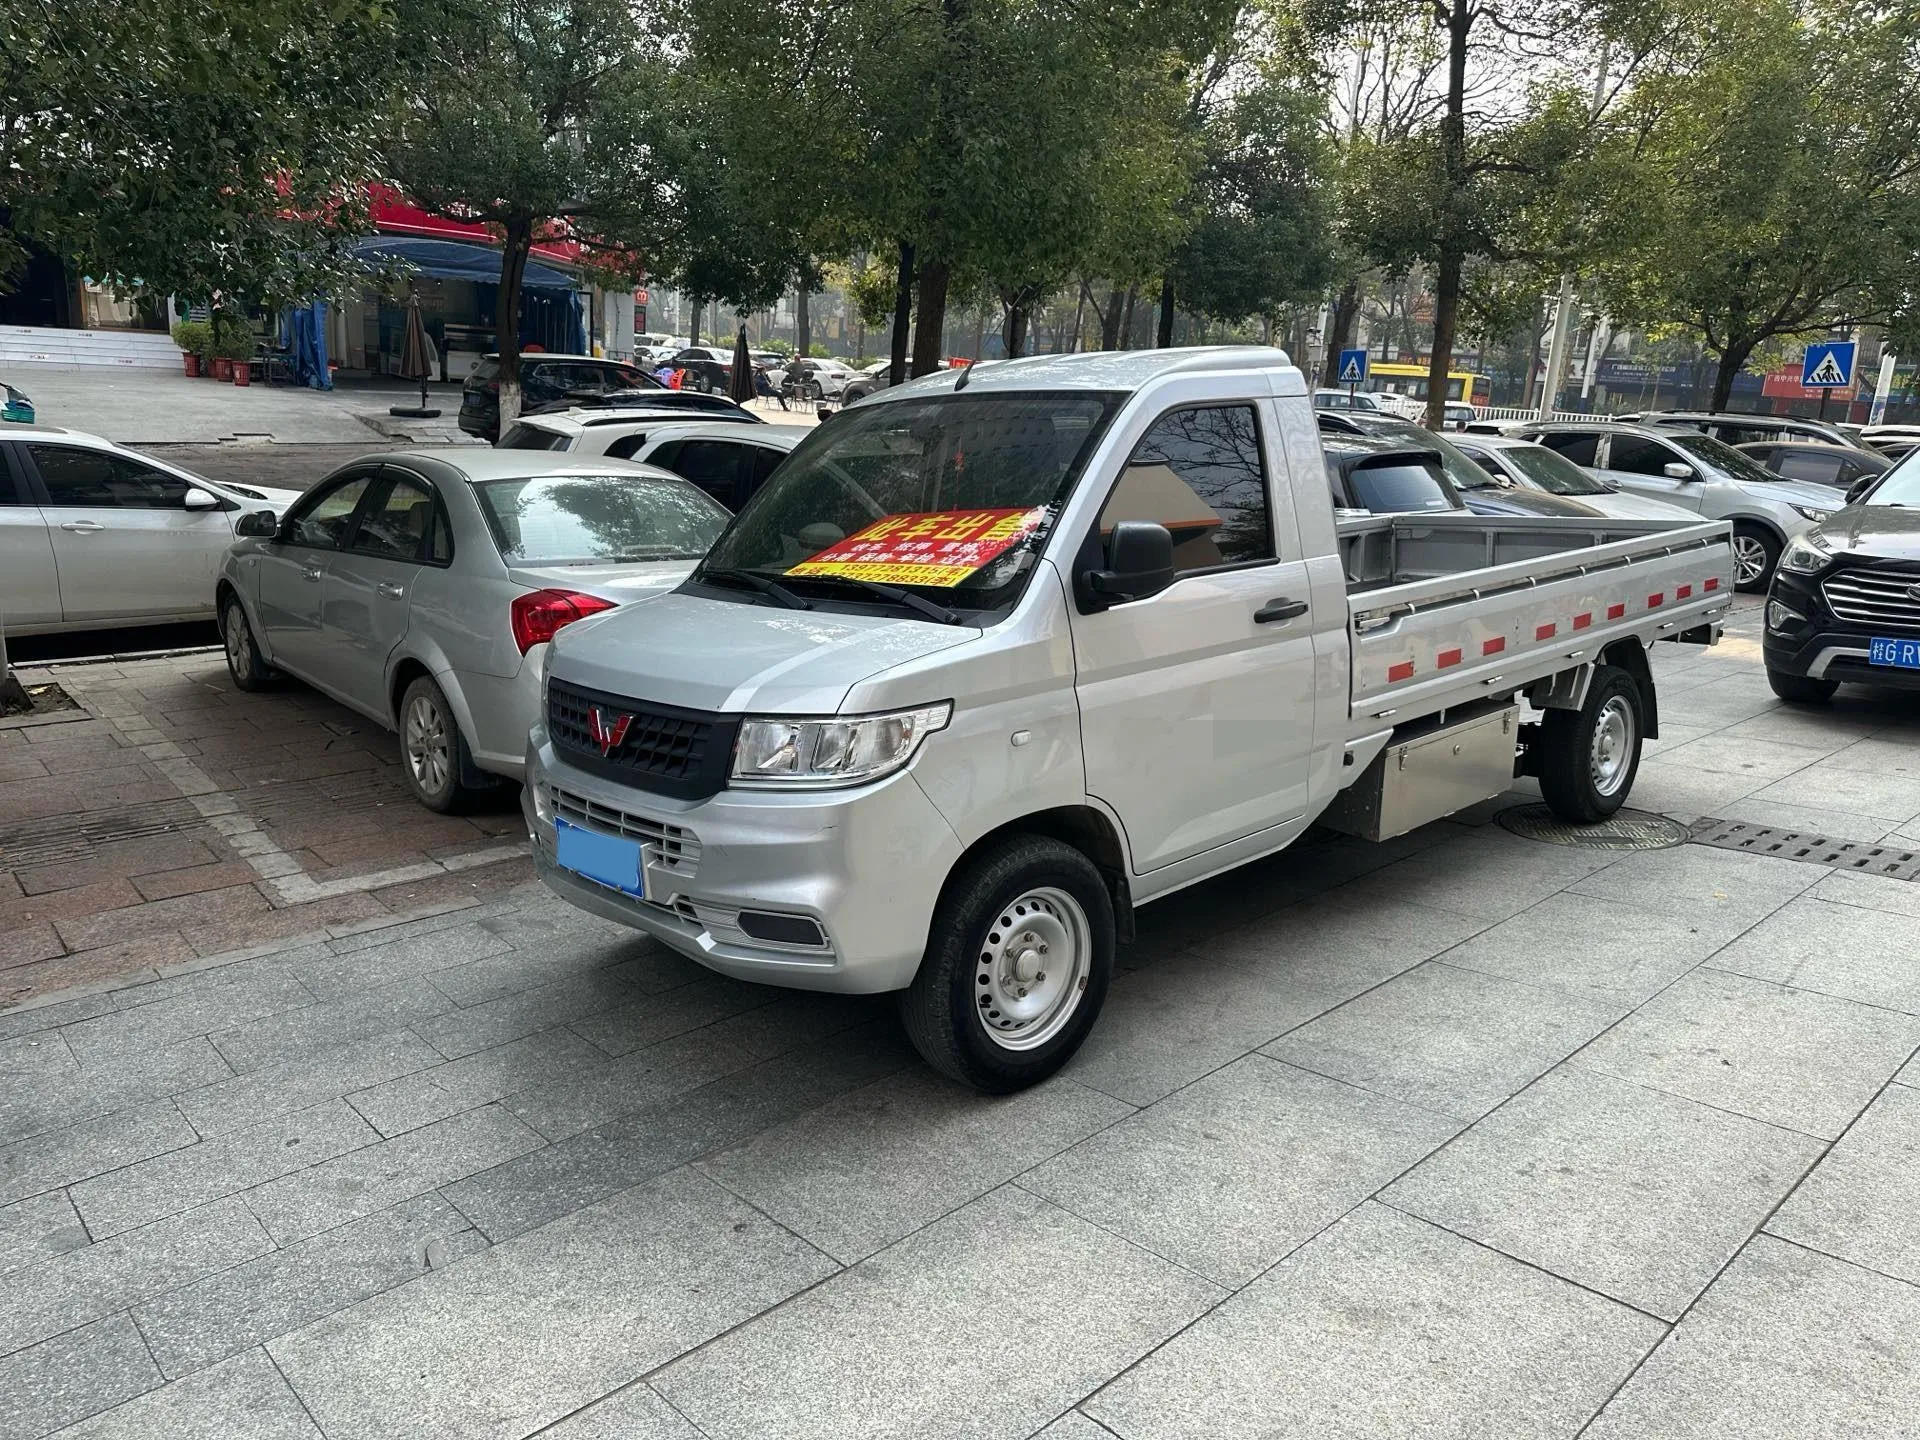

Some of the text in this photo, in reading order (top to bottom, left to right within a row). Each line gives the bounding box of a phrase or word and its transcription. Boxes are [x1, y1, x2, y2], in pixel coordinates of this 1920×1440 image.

[852, 512, 1031, 541] 此车出售
[894, 542, 932, 552] 抵押
[817, 552, 980, 566] 分期 保险 年检 过户
[1872, 641, 1920, 665] 桂G·R
